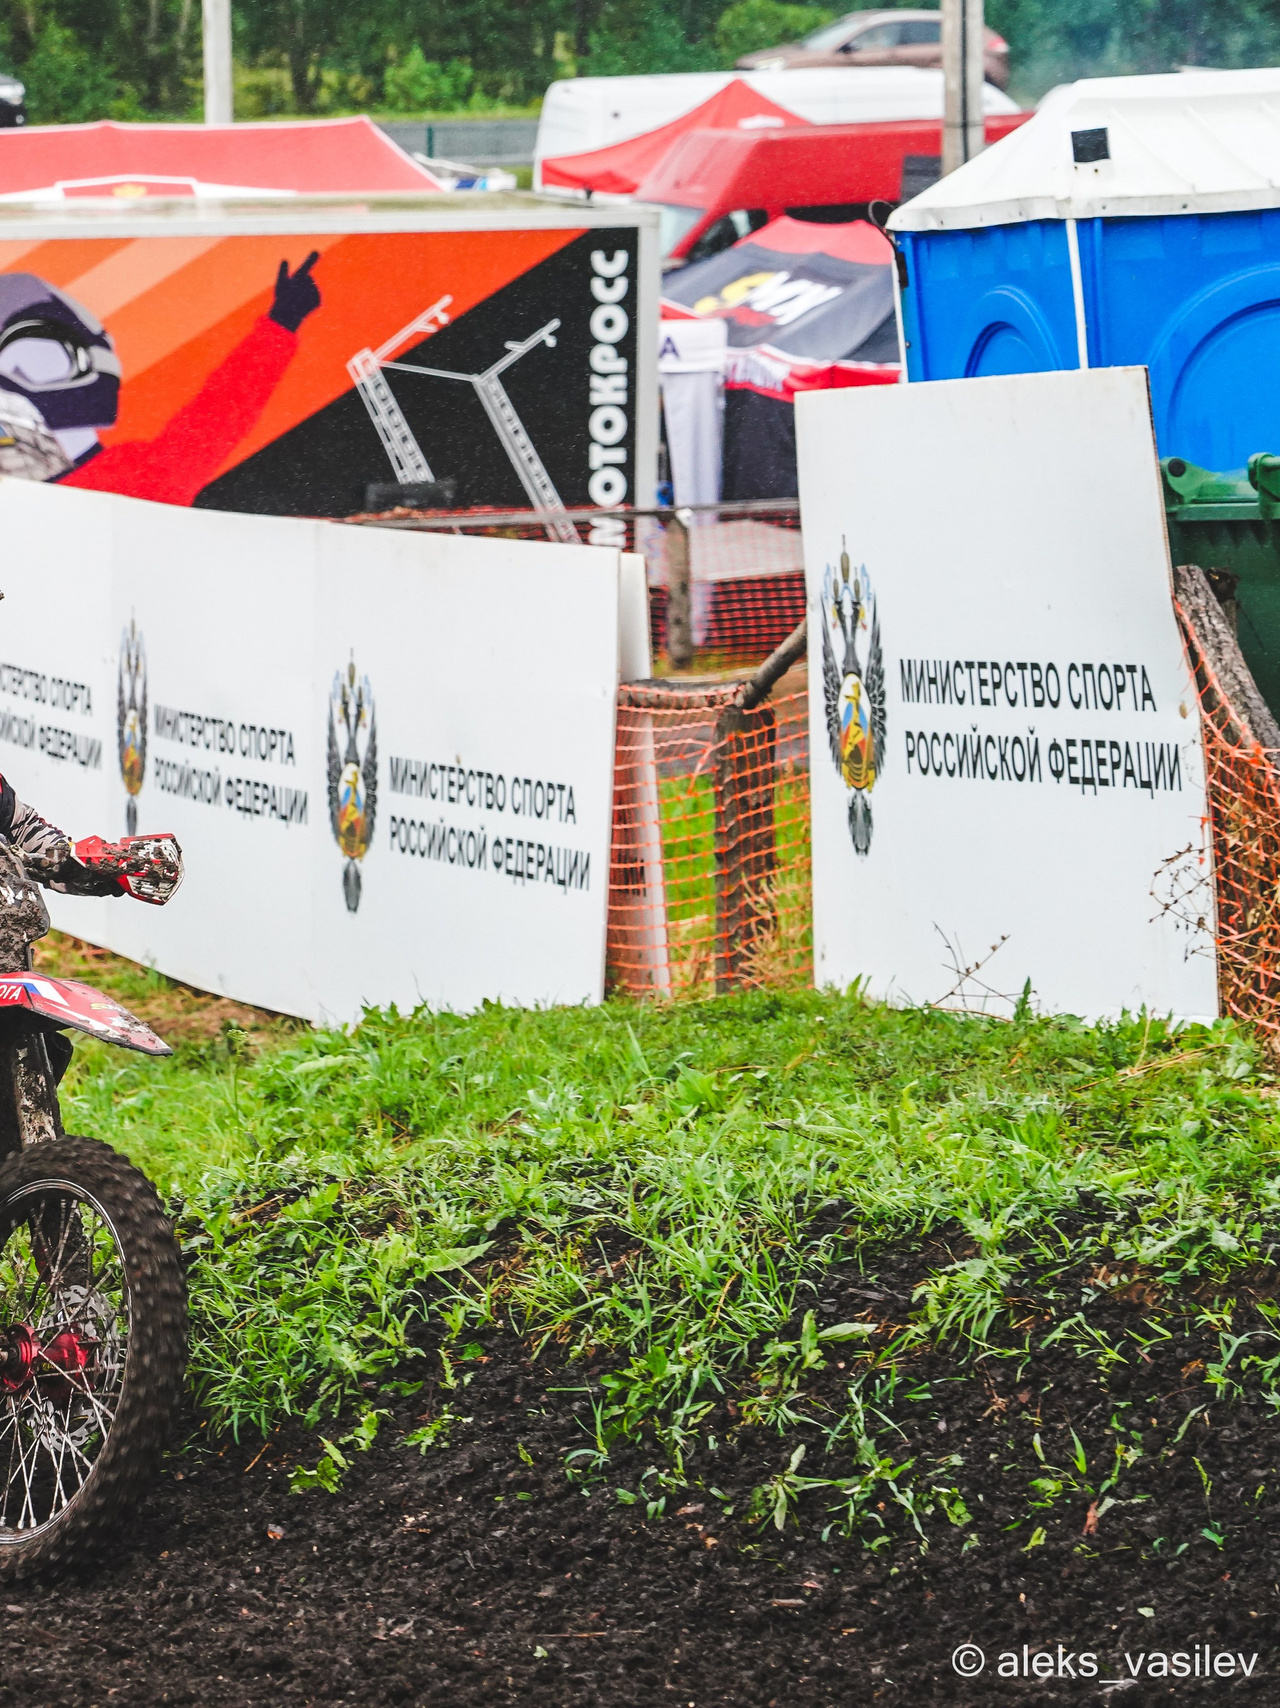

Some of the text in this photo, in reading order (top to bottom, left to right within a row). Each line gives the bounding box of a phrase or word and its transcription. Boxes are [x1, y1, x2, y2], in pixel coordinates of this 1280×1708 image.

[588, 250, 629, 546] МОТОКРОСС
[899, 658, 1157, 713] МИНИСТЕРСТВО СПОРТА
[154, 703, 296, 767] МИНИСТЕРСТВО СПОРТА
[905, 723, 1182, 799] РОССИЙСКОЙ ФЕДЕРАЦИИ
[154, 756, 309, 828] РОССИЙСКОЙ ФЕДЕРАЦИИ
[389, 755, 577, 825] МИНИСТЕРСТВО СПОРТА
[390, 814, 488, 871] РОССИЙСКОЙ
[492, 835, 591, 895] ФЕДЕРАЦИИ
